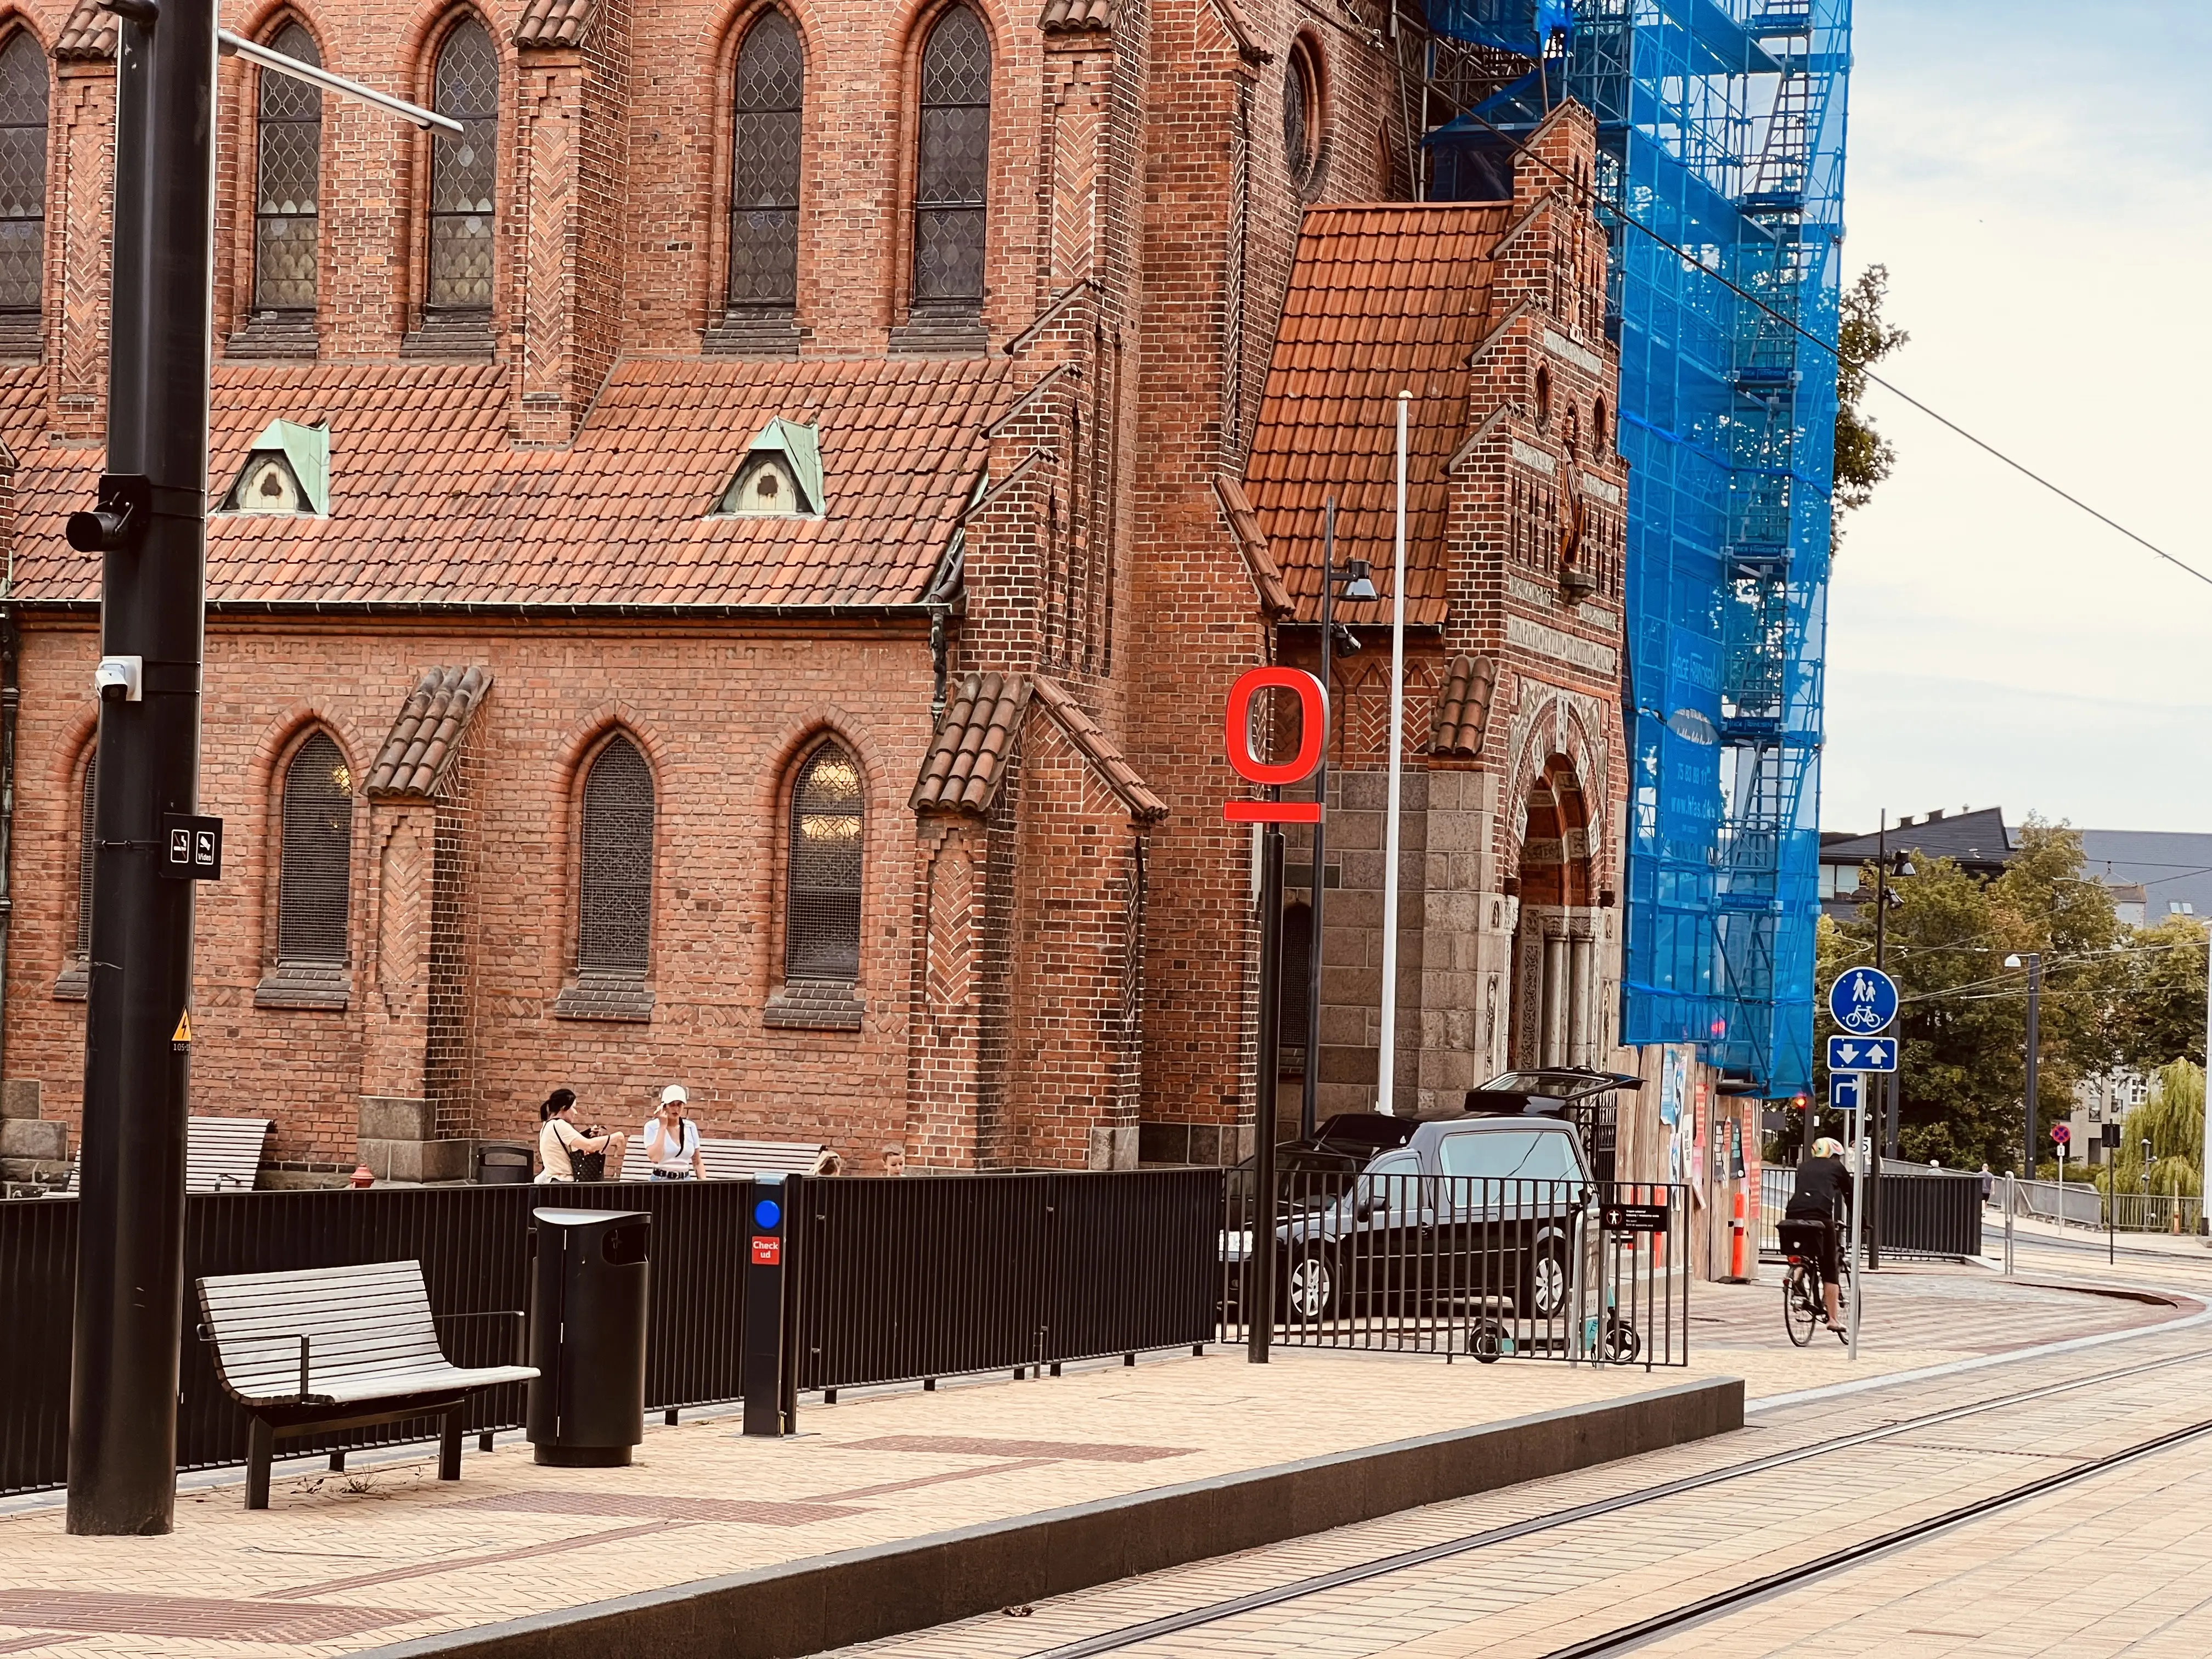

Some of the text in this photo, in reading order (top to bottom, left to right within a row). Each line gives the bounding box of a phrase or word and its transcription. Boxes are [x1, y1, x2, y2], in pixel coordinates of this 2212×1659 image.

[198, 853, 211, 861] Video
[753, 1241, 778, 1250] Check
[760, 1250, 771, 1259] ud
